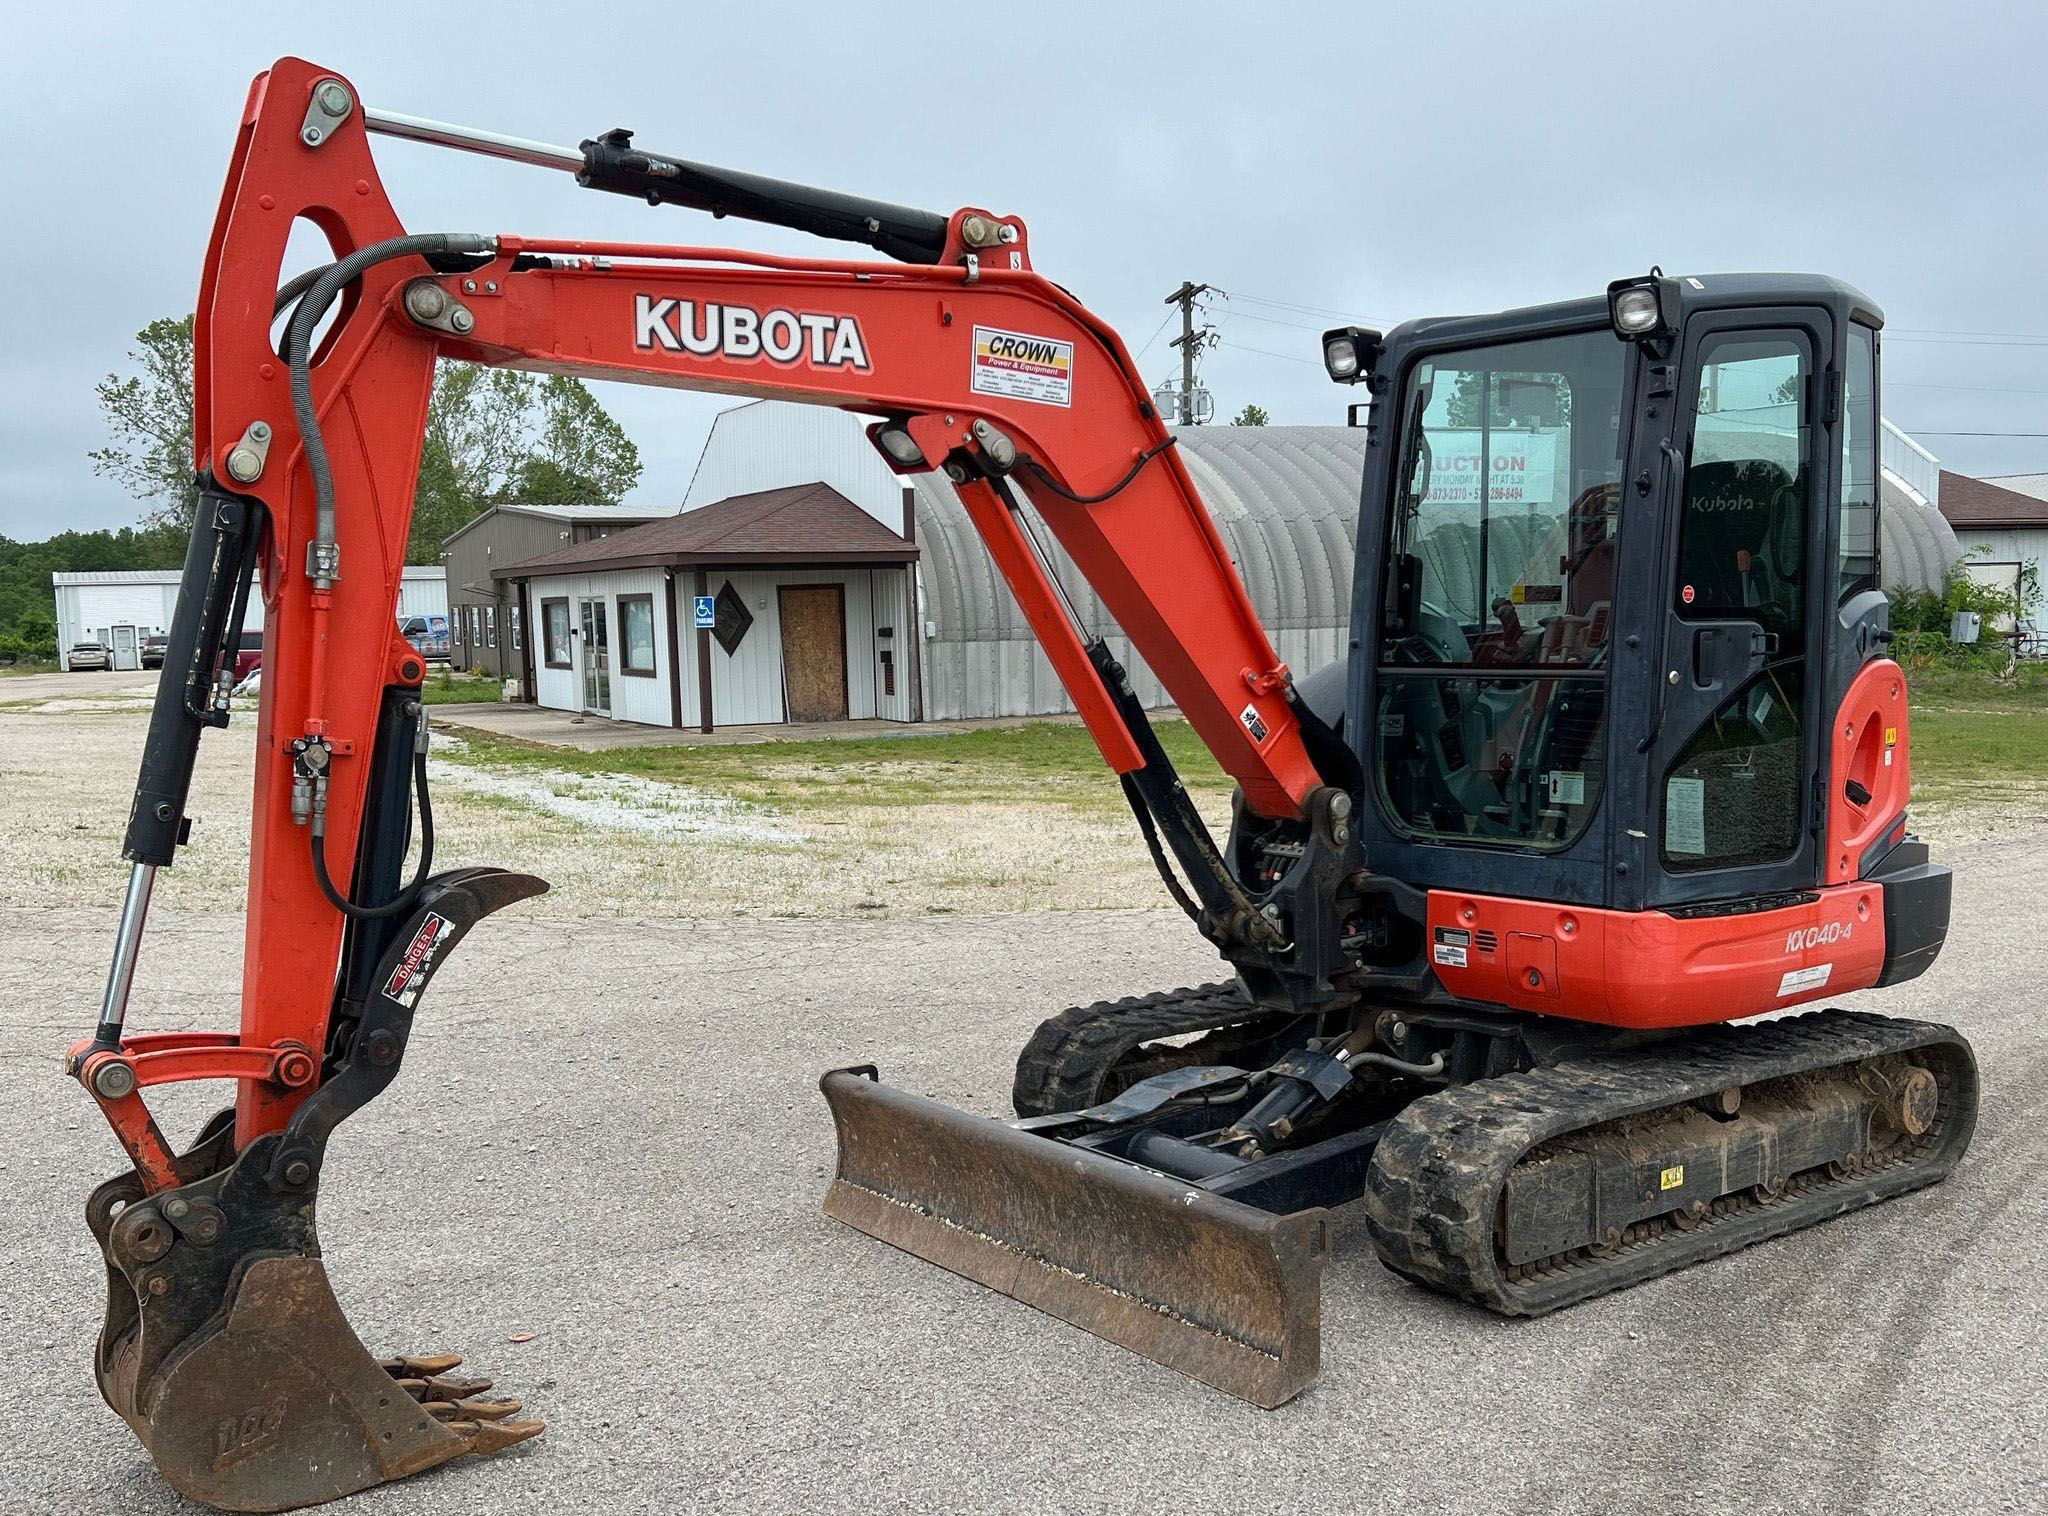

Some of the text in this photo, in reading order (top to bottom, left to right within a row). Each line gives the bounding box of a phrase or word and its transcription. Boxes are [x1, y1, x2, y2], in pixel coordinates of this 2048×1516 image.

[635, 295, 869, 369] KUBOTA
[990, 336, 1057, 364] CROWN
[988, 357, 1012, 368] Power
[1012, 361, 1018, 369] &
[1020, 362, 1058, 376] Equipment
[1418, 455, 1525, 471] UCTON
[1443, 474, 1474, 485] MONDAY
[1475, 474, 1498, 485] NHT
[1500, 474, 1509, 485] AT
[1692, 495, 1754, 513] Kubota
[399, 934, 431, 979] DANGER
